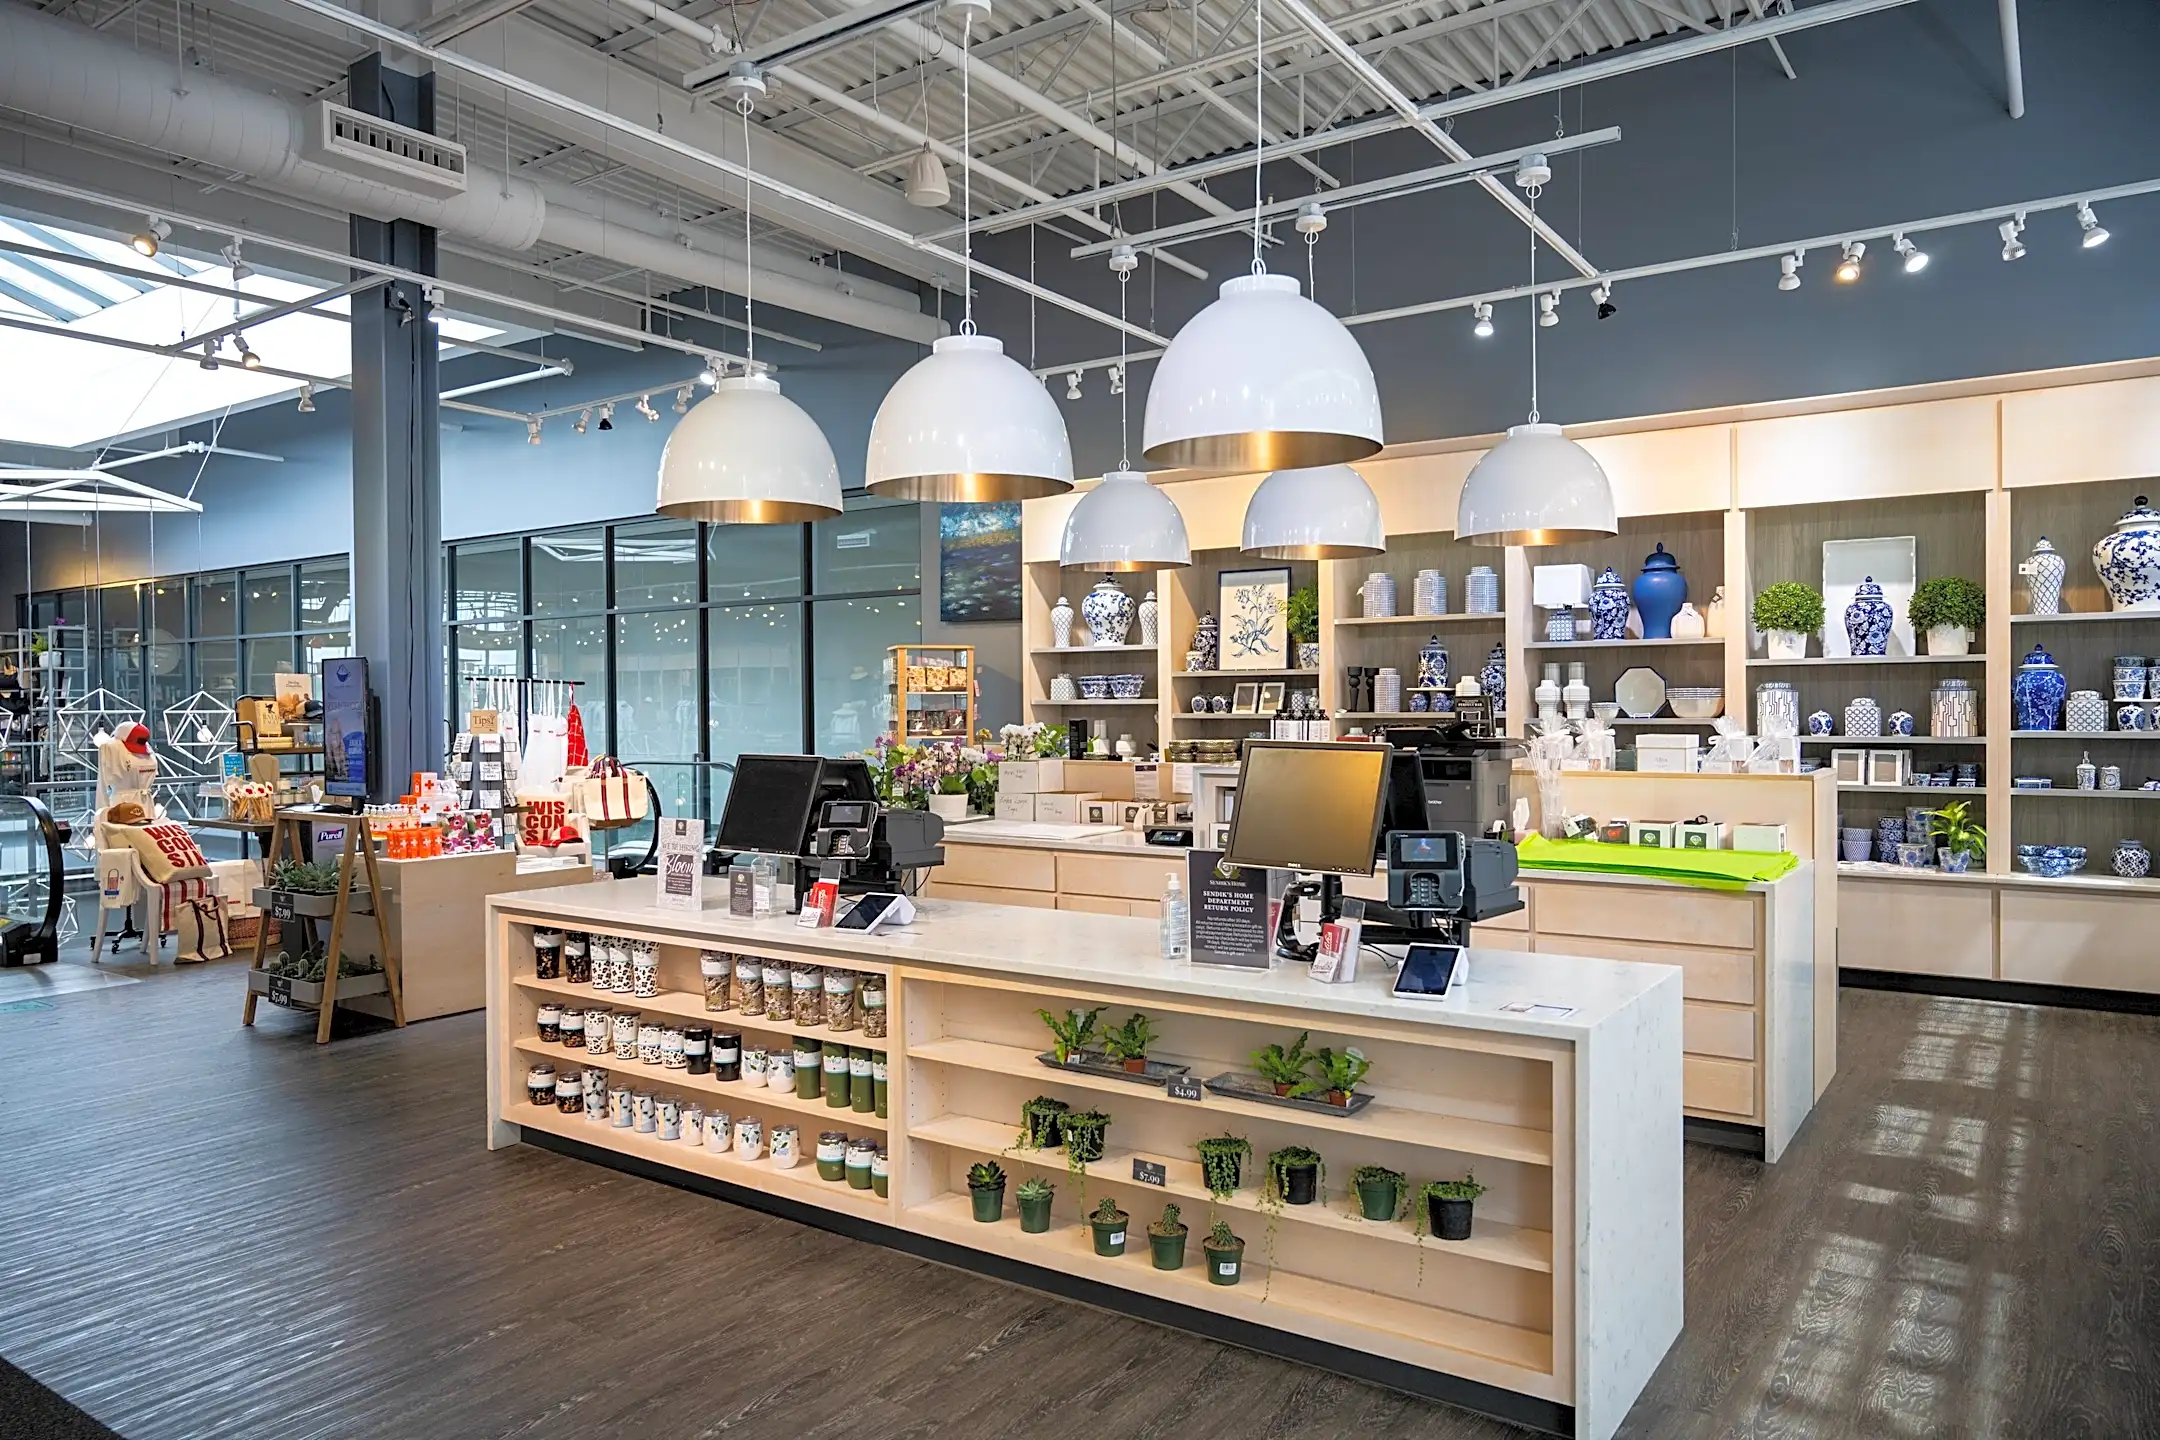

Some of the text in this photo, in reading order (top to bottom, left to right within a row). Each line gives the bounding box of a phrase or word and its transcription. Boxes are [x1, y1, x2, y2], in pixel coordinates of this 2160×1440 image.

[527, 801, 565, 815] WIS
[526, 816, 565, 830] CON
[143, 824, 188, 839] WIS
[320, 830, 342, 840] Purell
[157, 836, 196, 852] CON
[665, 854, 695, 875] Bloom
[1208, 898, 1250, 906] DEPARTMENT
[275, 905, 290, 919] $7.99
[272, 990, 288, 1005] $7.99
[1174, 1086, 1197, 1098] $4.99
[1139, 1171, 1160, 1184] $7.99
